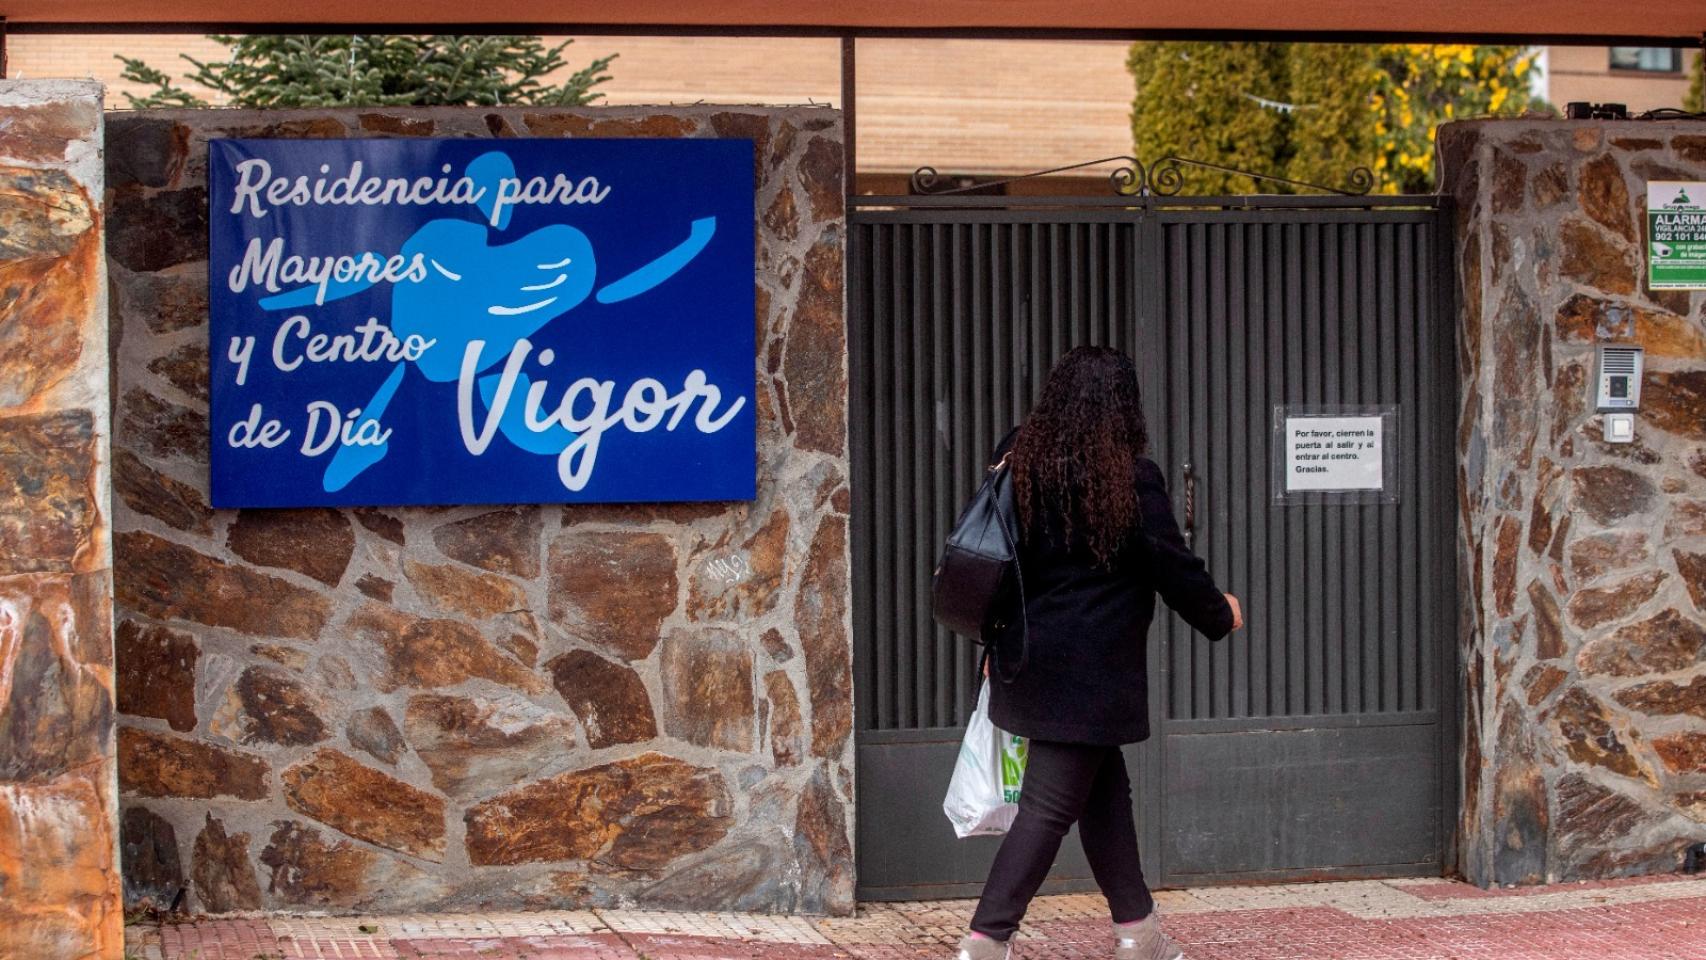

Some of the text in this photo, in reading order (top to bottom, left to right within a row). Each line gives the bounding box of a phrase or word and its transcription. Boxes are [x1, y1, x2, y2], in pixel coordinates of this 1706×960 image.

[229, 157, 611, 227] Residencia para
[1656, 214, 1706, 225] ALARMA
[1655, 233, 1672, 241] 902
[1675, 233, 1690, 241] 101
[229, 236, 428, 306] Mayores
[228, 314, 436, 386] y Centro
[457, 338, 747, 492] Vigor
[228, 400, 393, 457] de Día
[1295, 430, 1309, 438] Por
[1311, 429, 1334, 438] favor,
[1336, 429, 1365, 437] cierren
[1295, 442, 1321, 450] puerta
[1325, 441, 1333, 449] al
[1336, 441, 1355, 449] salir
[1358, 442, 1363, 450] y
[1295, 453, 1320, 461] entrar
[1331, 452, 1360, 460] centro.
[1295, 465, 1329, 474] Gracias.
